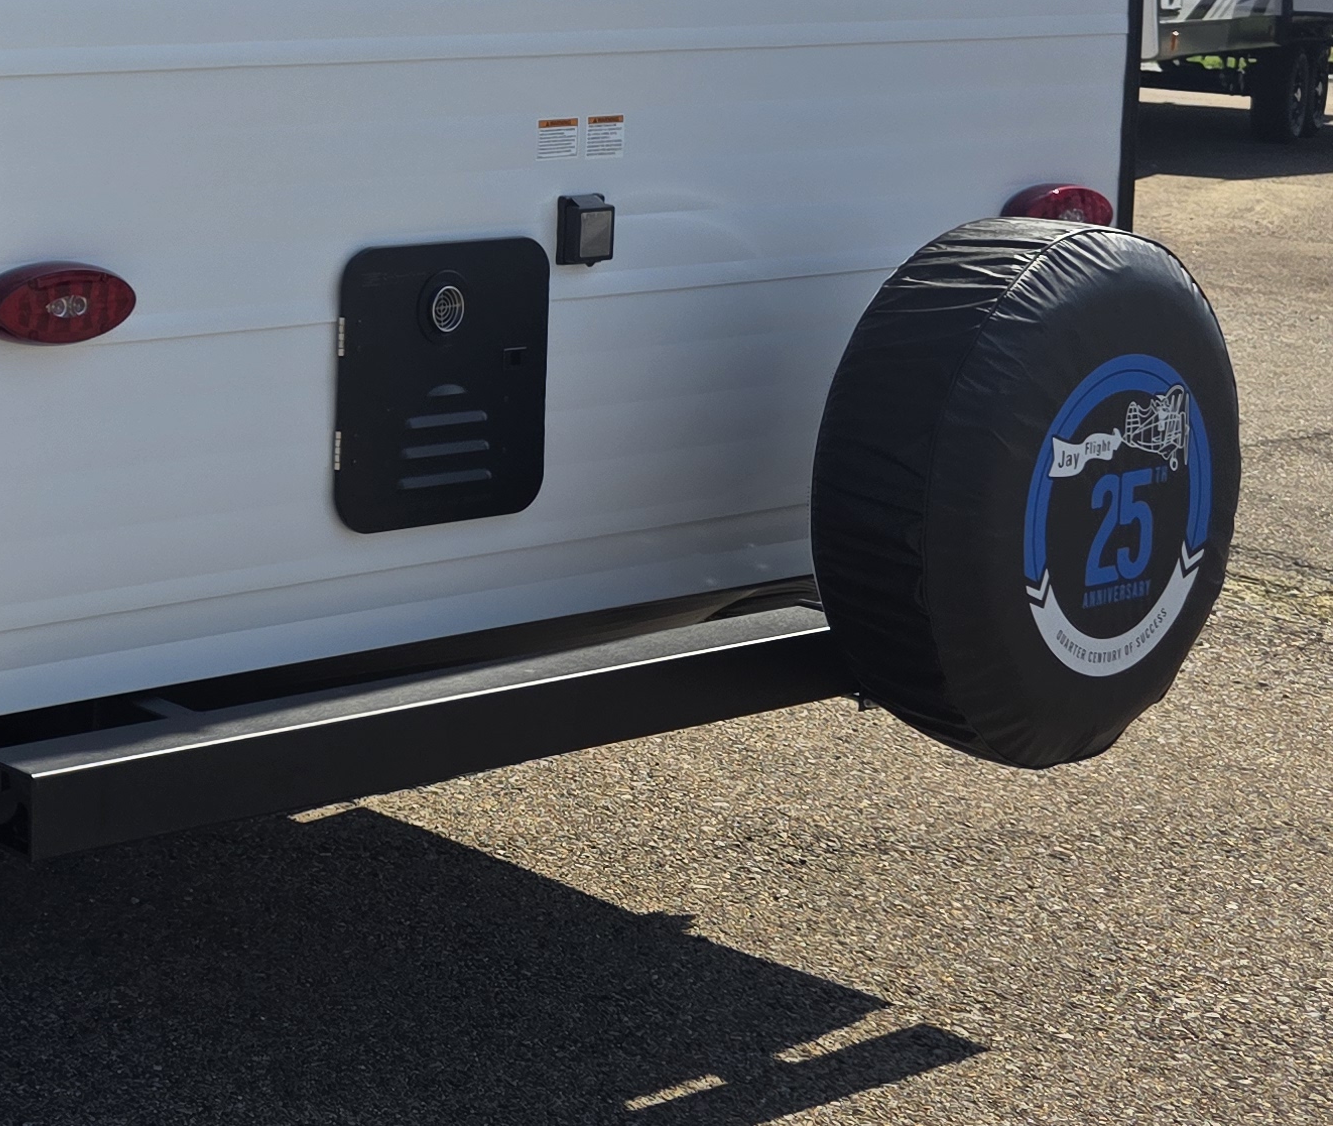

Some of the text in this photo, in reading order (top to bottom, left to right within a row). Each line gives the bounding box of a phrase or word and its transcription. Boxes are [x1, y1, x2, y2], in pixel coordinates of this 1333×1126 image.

[1057, 439, 1111, 470] Jay Flight
[1082, 578, 1152, 609] ANNIVERSARY
[1056, 607, 1168, 664] QUARTER CENTURY OF SUCCESS
